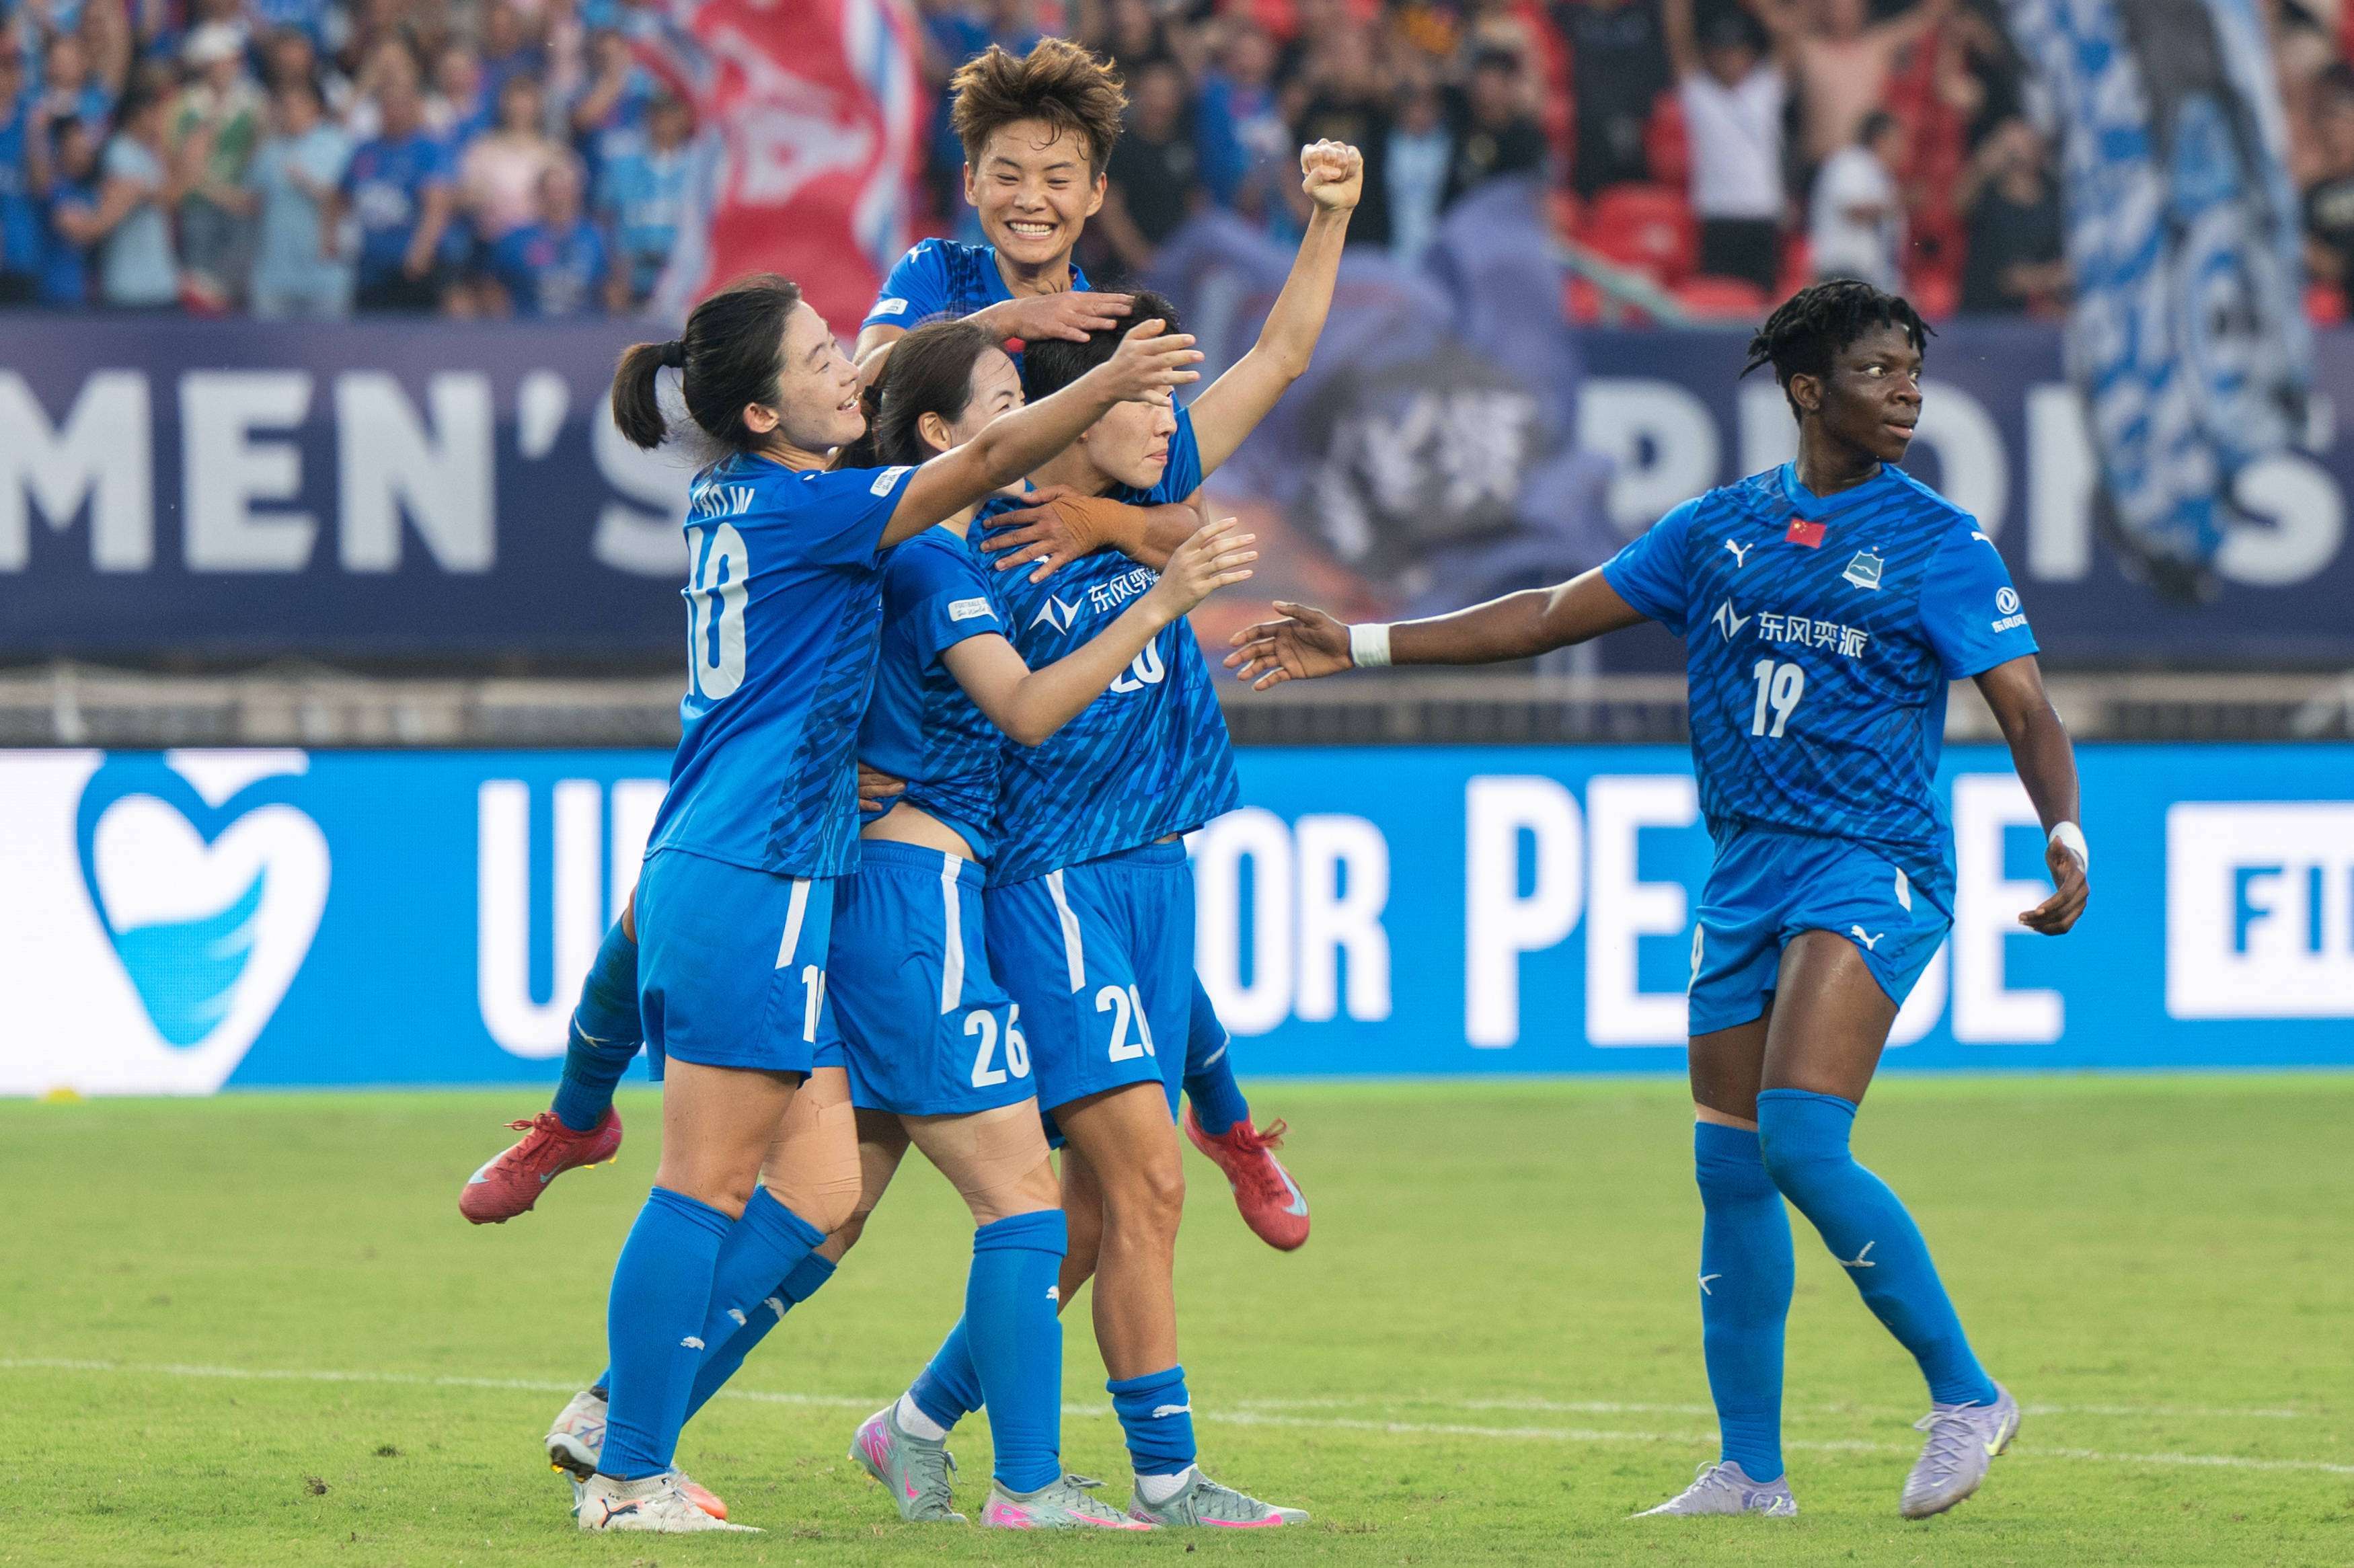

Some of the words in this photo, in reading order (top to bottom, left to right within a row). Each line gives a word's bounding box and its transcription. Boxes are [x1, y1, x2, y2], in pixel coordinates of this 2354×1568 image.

[687, 522, 749, 700] 10
[1758, 611, 1869, 658] 东风奕派
[1751, 659, 1805, 738] 19
[1186, 805, 1393, 1037] OR
[1464, 773, 2065, 1050] PEE
[2229, 862, 2354, 956] FI
[963, 1003, 1030, 1088] 26
